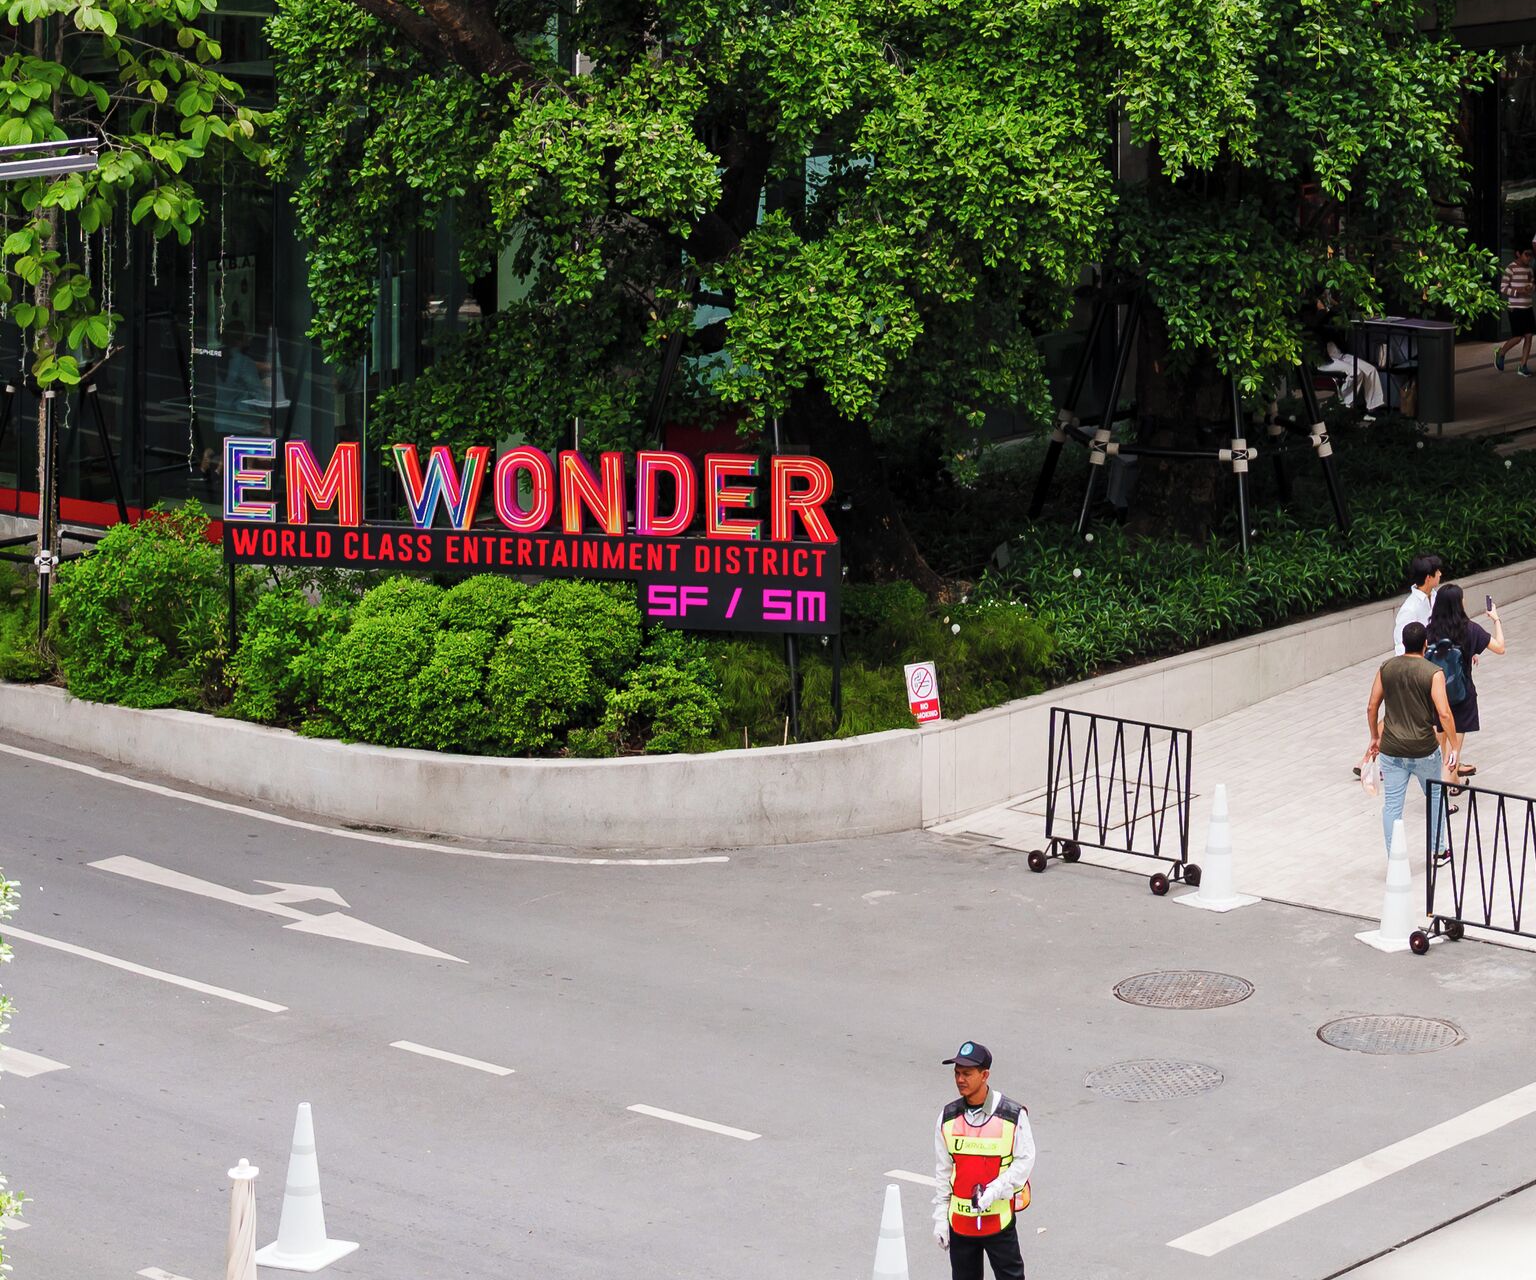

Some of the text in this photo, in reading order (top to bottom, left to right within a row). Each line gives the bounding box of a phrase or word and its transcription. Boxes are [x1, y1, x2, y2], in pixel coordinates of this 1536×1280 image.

[223, 435, 838, 543] EM WONDER
[231, 529, 827, 578] WORLD CLASS ENTERTAINMENT DISTRICT
[920, 702, 929, 710] NO
